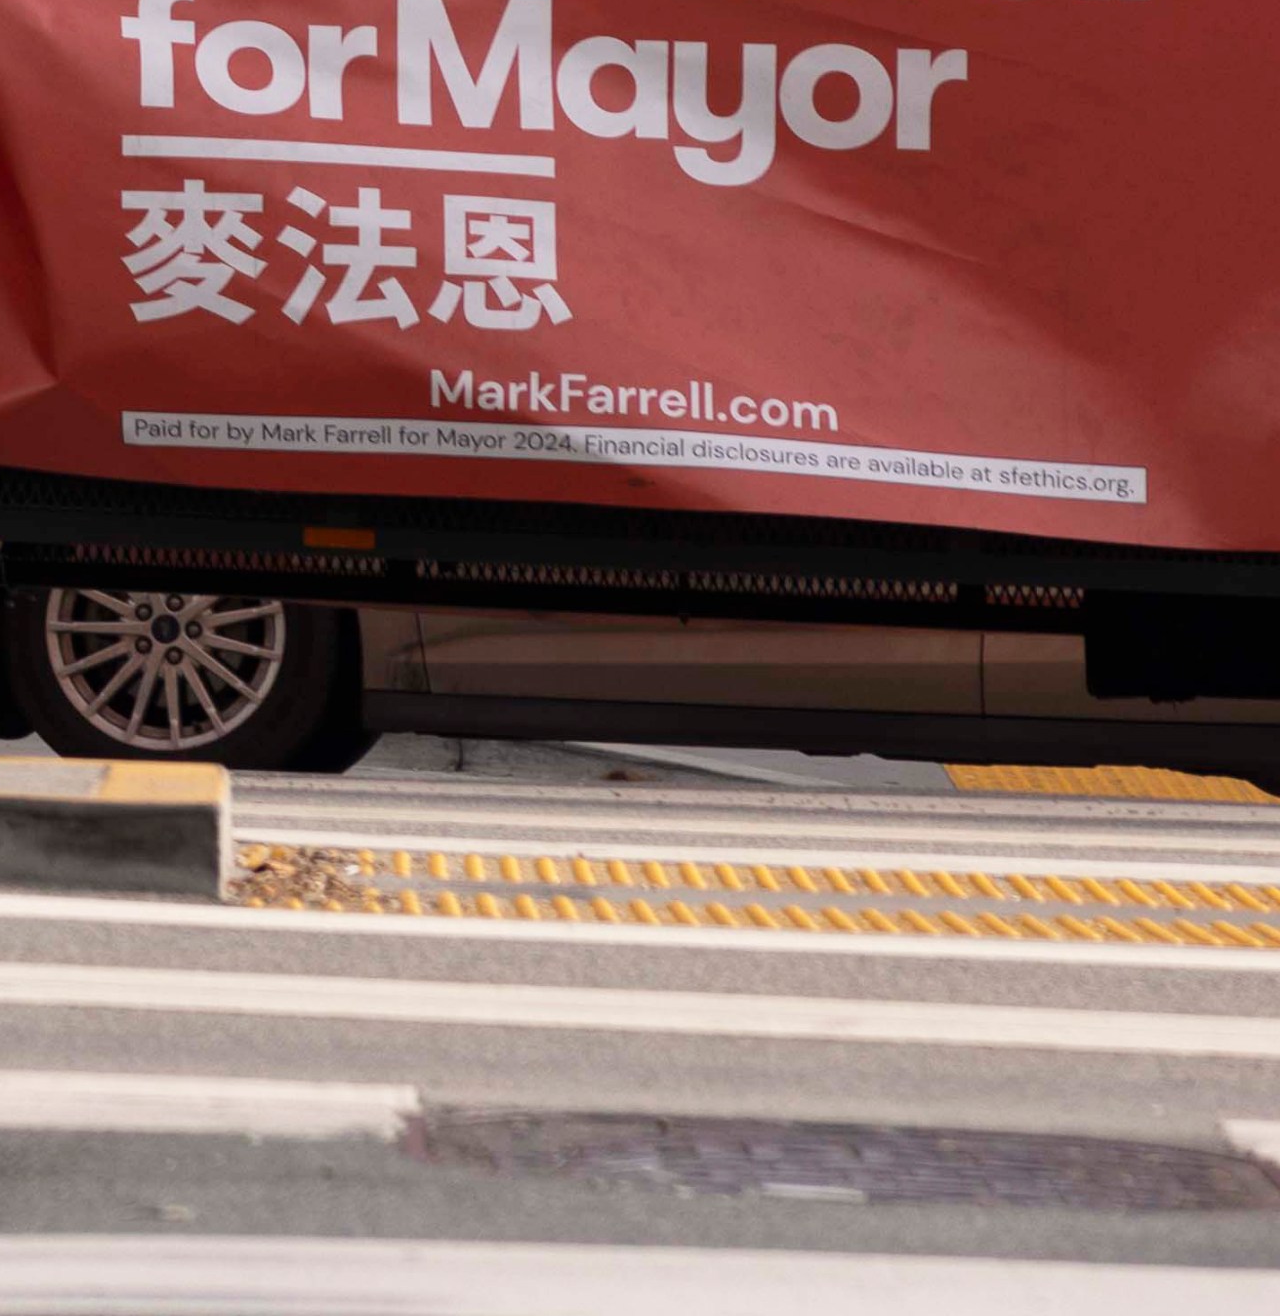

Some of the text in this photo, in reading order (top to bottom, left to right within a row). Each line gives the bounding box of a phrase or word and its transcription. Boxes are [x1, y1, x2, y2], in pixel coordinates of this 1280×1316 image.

[120, 178, 573, 331] 麥法恩
[429, 369, 840, 431] MarkFarrell.com
[134, 418, 1135, 498] Paid for by Mark Farrell for Mayor 2024. Financial disclosures are available at sfethics.org.
